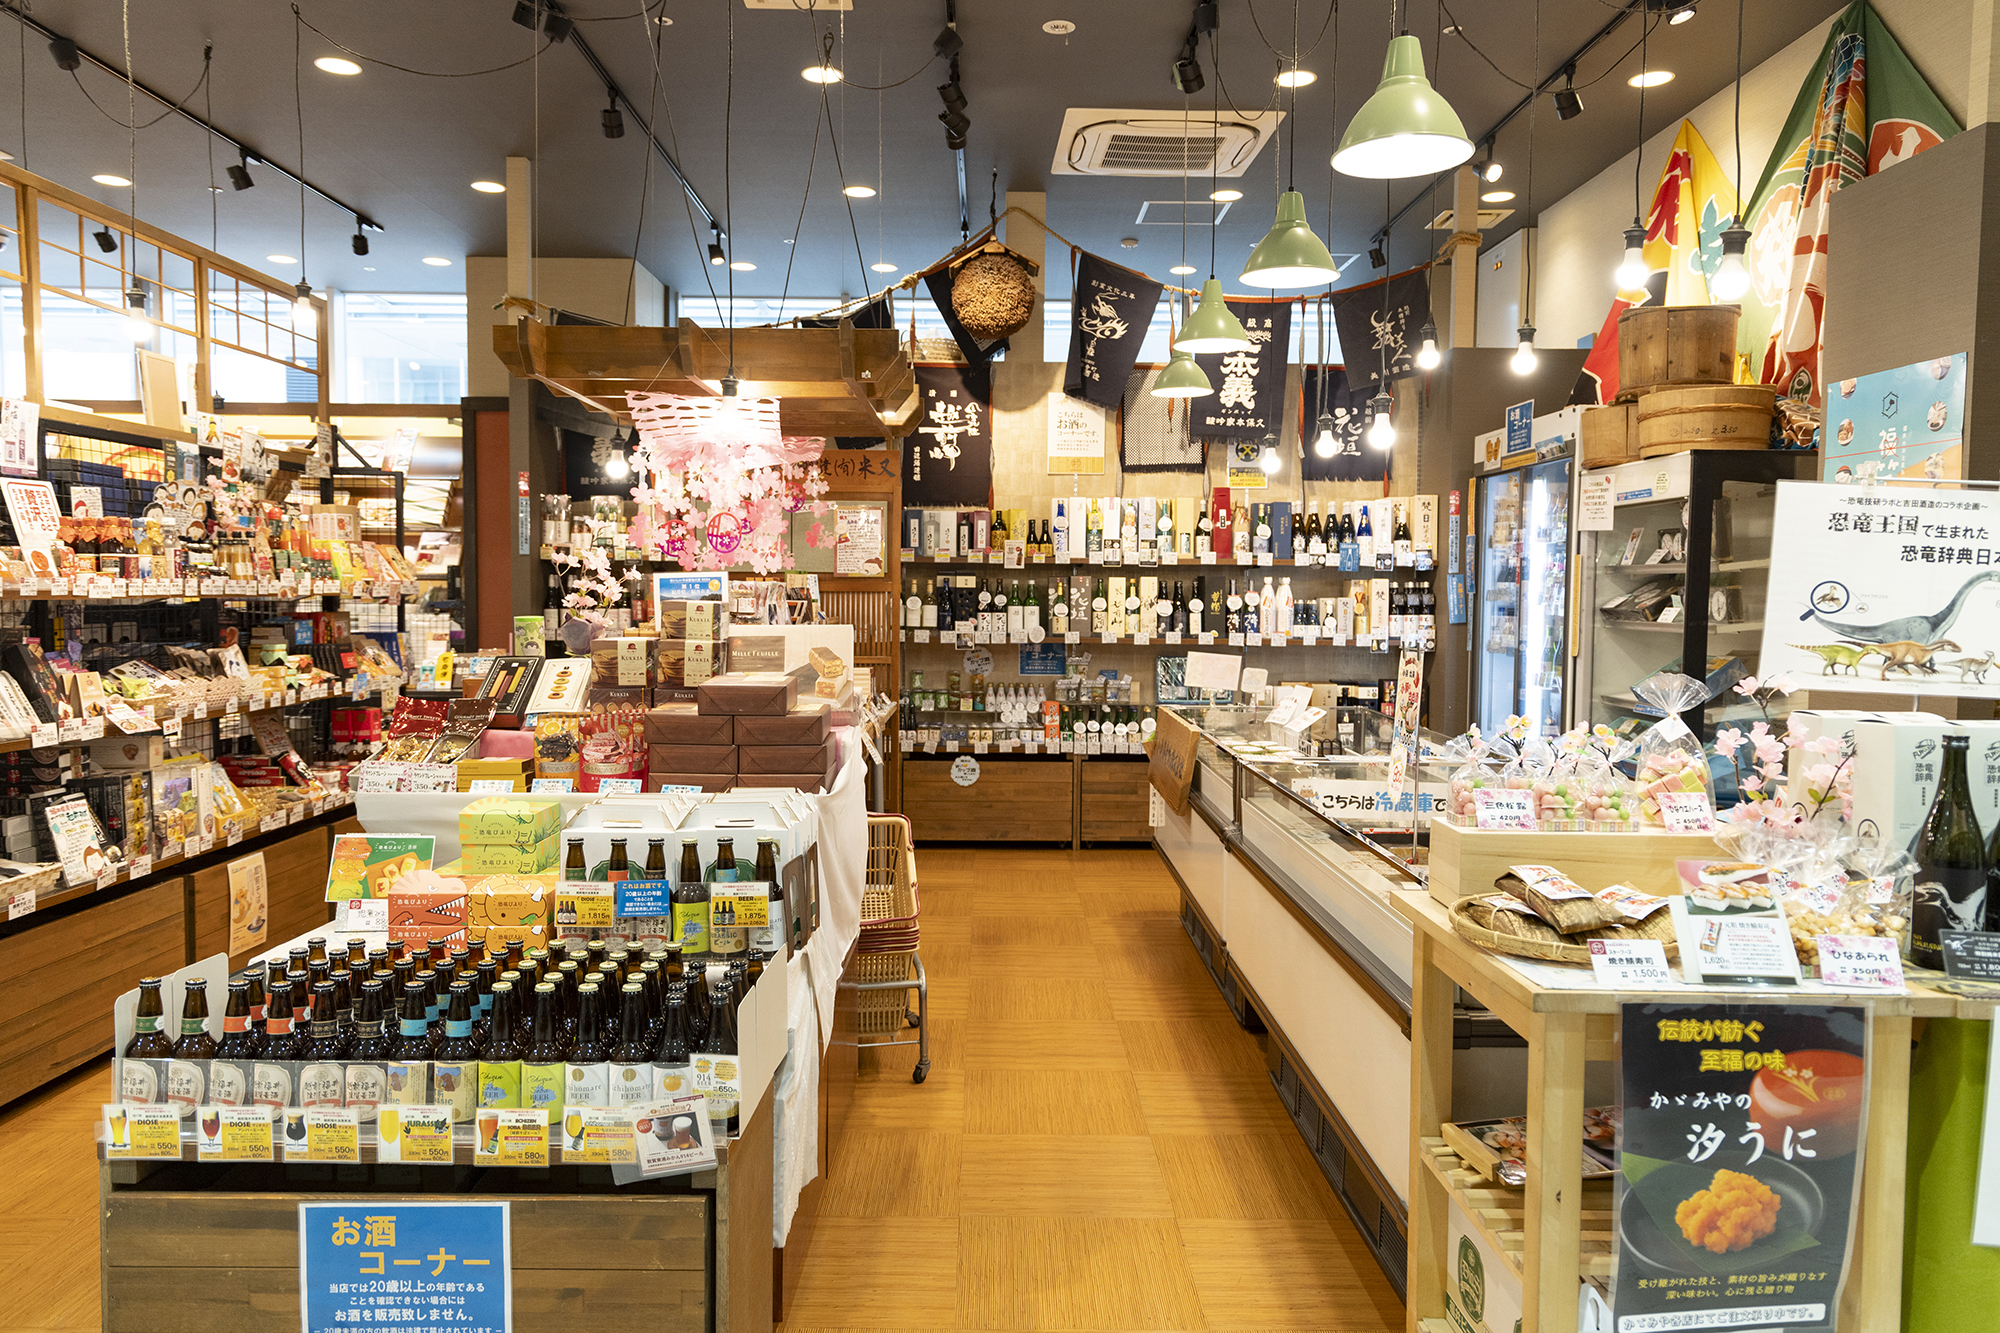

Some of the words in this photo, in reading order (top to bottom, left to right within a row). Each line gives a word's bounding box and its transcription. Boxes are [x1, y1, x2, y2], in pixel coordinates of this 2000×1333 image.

[1057, 419, 1087, 429] お酒の
[1514, 417, 1530, 429] コーナー
[1828, 512, 1989, 540] 恐竜王国で生まれた
[1915, 763, 1933, 772] 恐竜
[1915, 773, 1933, 782] 辞典
[1608, 957, 1654, 965] 焼き鯖寿司
[1831, 950, 1890, 962] ひなあられ
[1657, 1018, 1765, 1042] 伝統が紡ぐ
[1699, 1050, 1787, 1072] 至福の味
[696, 1073, 711, 1082] 914
[1686, 1122, 1817, 1165] 汐うに
[524, 1151, 545, 1160] 580円
[612, 1149, 632, 1157] 580円
[332, 1216, 396, 1247] お酒
[360, 1248, 490, 1277] コーナー
[329, 1280, 485, 1294] 当店では20歳以上の年齢である
[1666, 1286, 1795, 1300] 深い味わい。心に残る贈り物
[350, 1296, 465, 1305] ことを確認できない場合には
[335, 1309, 474, 1322] お酒を販売致しません。
